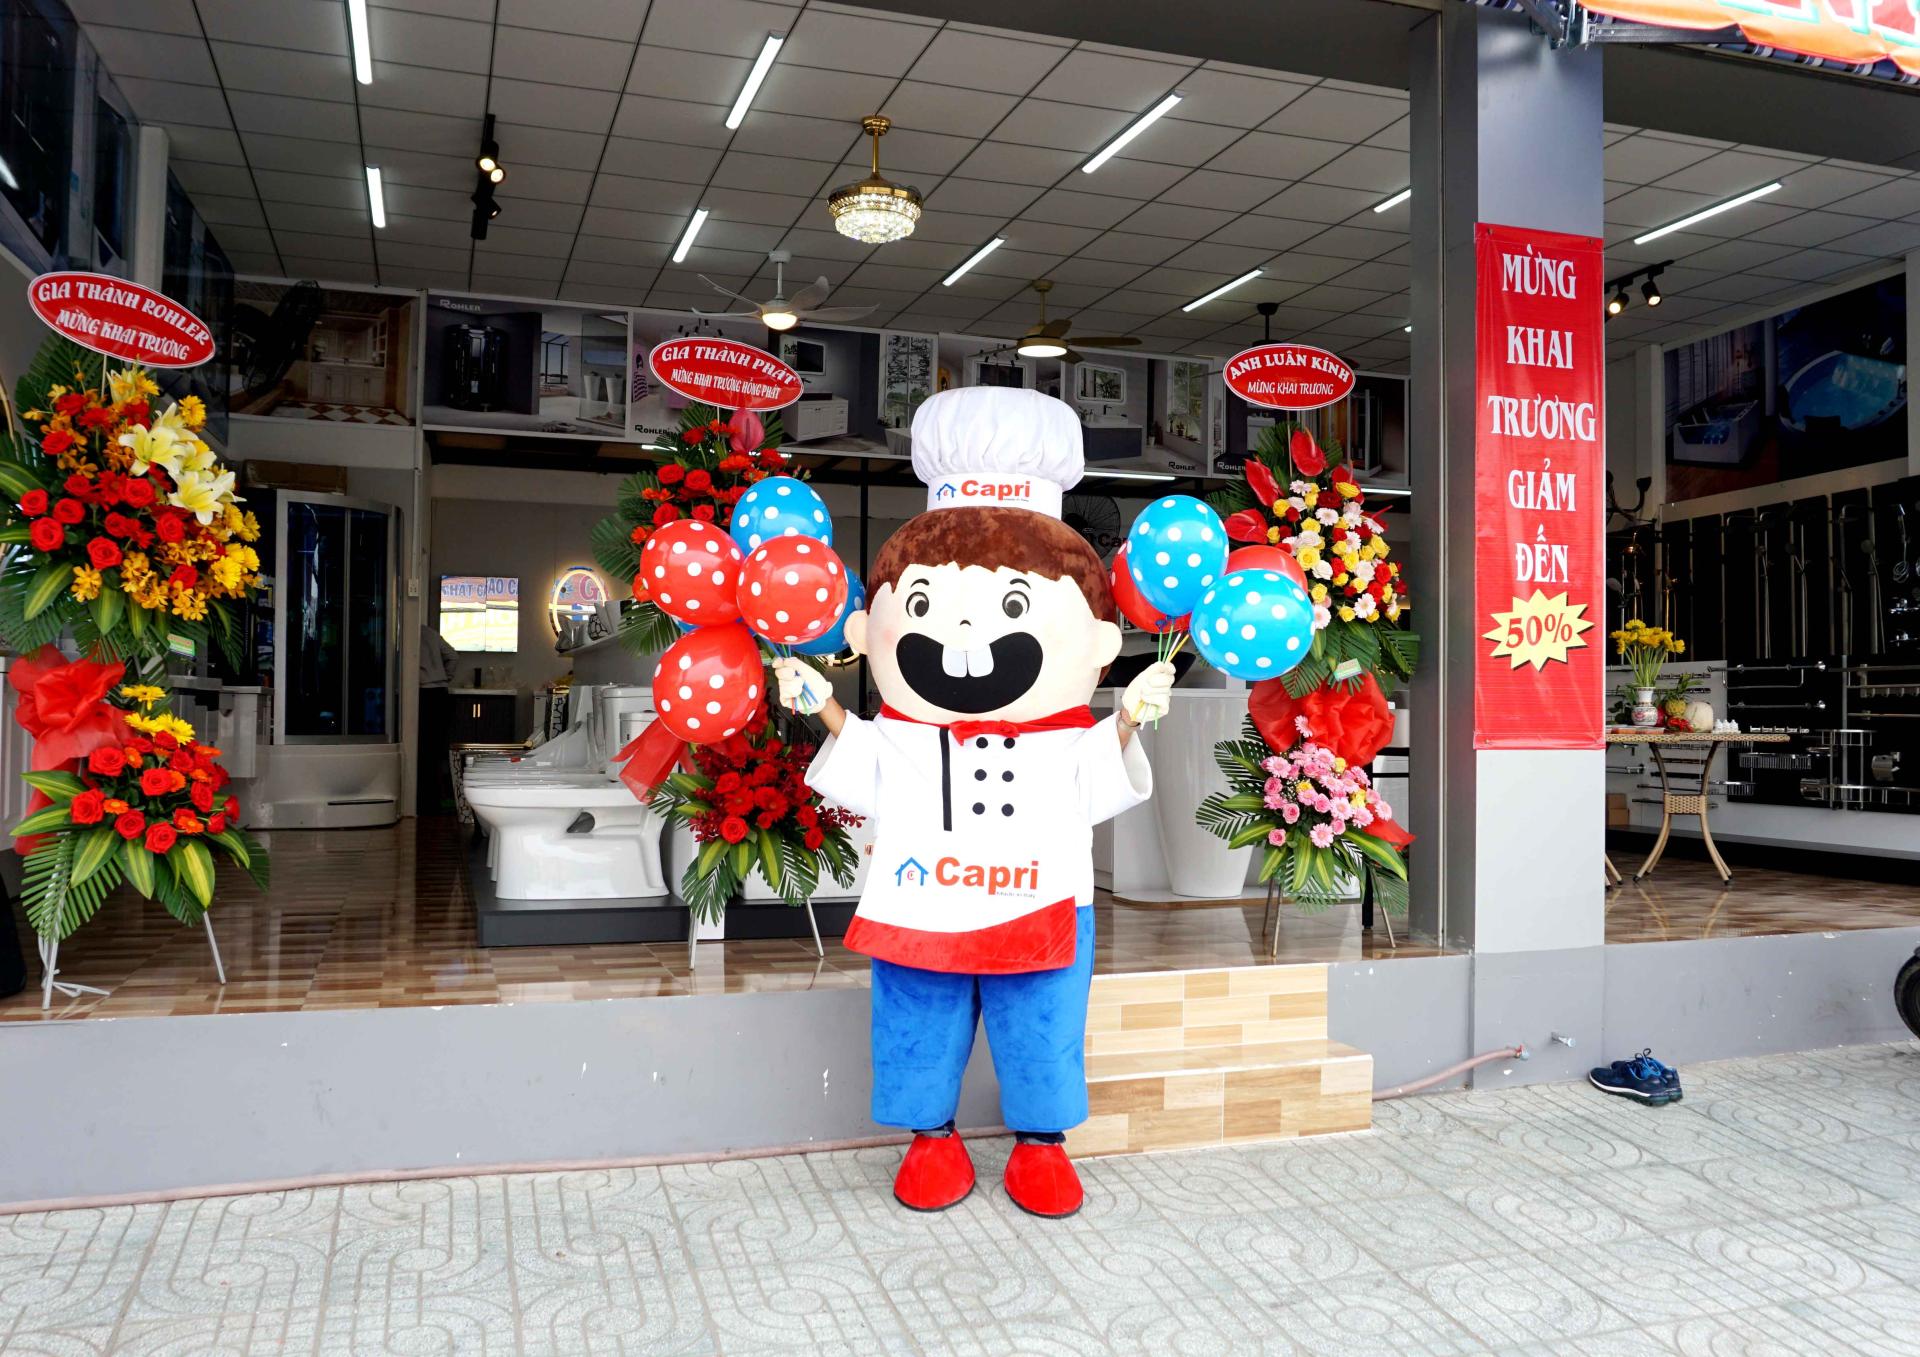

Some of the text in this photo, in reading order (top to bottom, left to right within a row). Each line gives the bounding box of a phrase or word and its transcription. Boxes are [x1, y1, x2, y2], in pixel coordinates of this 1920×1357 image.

[1502, 243, 1577, 300] MỪNG
[38, 282, 210, 346] GIA THÀNH ROHLER
[55, 308, 190, 361] MỪNG KHAI TRƯƠNG
[661, 345, 797, 386] GIA THÀNH PHÁT
[1230, 350, 1351, 383] ANH LUÂN KÍNH
[1506, 325, 1575, 370] KHAI
[671, 366, 695, 385] MỪNG
[693, 373, 712, 388] KHAI
[1247, 379, 1335, 395] MỪNG KHAI TRƯƠNG
[1488, 393, 1597, 441] TRƯƠNG
[961, 479, 1031, 501] Capri
[1508, 458, 1577, 512] GIẢM
[1515, 523, 1569, 584] ĐẾN
[1506, 613, 1573, 649] 50%
[935, 856, 1040, 896] Capri
